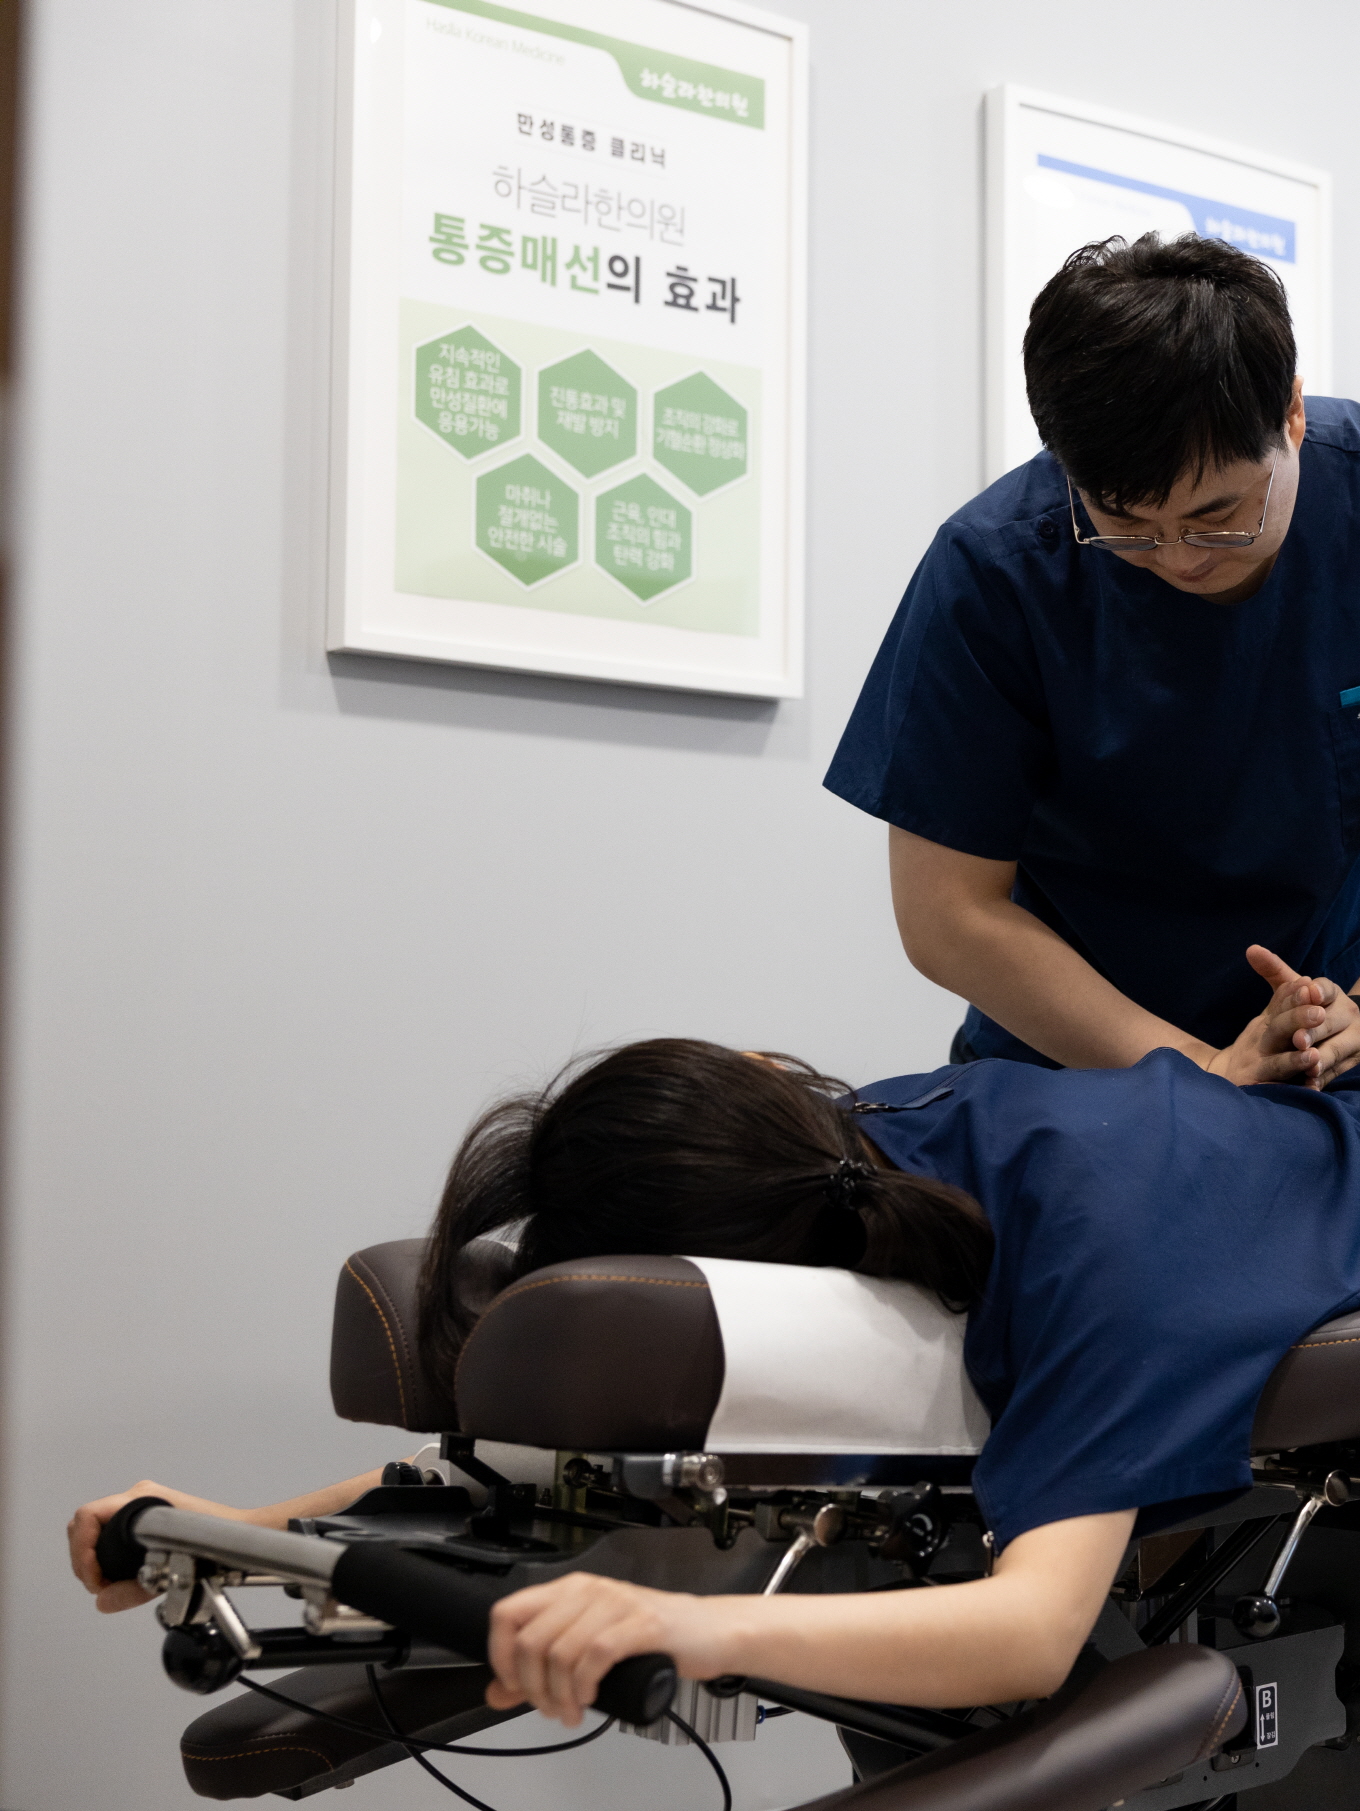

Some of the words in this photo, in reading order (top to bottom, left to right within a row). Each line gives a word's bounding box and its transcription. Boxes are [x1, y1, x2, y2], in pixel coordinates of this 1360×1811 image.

[465, 27, 510, 51] Korean
[511, 39, 567, 65] Medicine
[639, 66, 750, 118] 하슬라한의원
[516, 112, 597, 153] 만성통증
[609, 135, 667, 169] 클리닉
[492, 165, 687, 248] 하슬라한의원
[428, 211, 642, 304] 통증매선의
[664, 265, 741, 325] 효과
[438, 342, 502, 375] 지속적인
[462, 370, 511, 396] 효과로
[429, 385, 509, 421] 만성질환에
[437, 410, 501, 442] 응용가능
[588, 414, 620, 441] 방지
[504, 483, 552, 511] 마취나
[487, 525, 535, 553] 안전한
[536, 534, 568, 559] 시술
[1262, 1690, 1272, 1708] B
